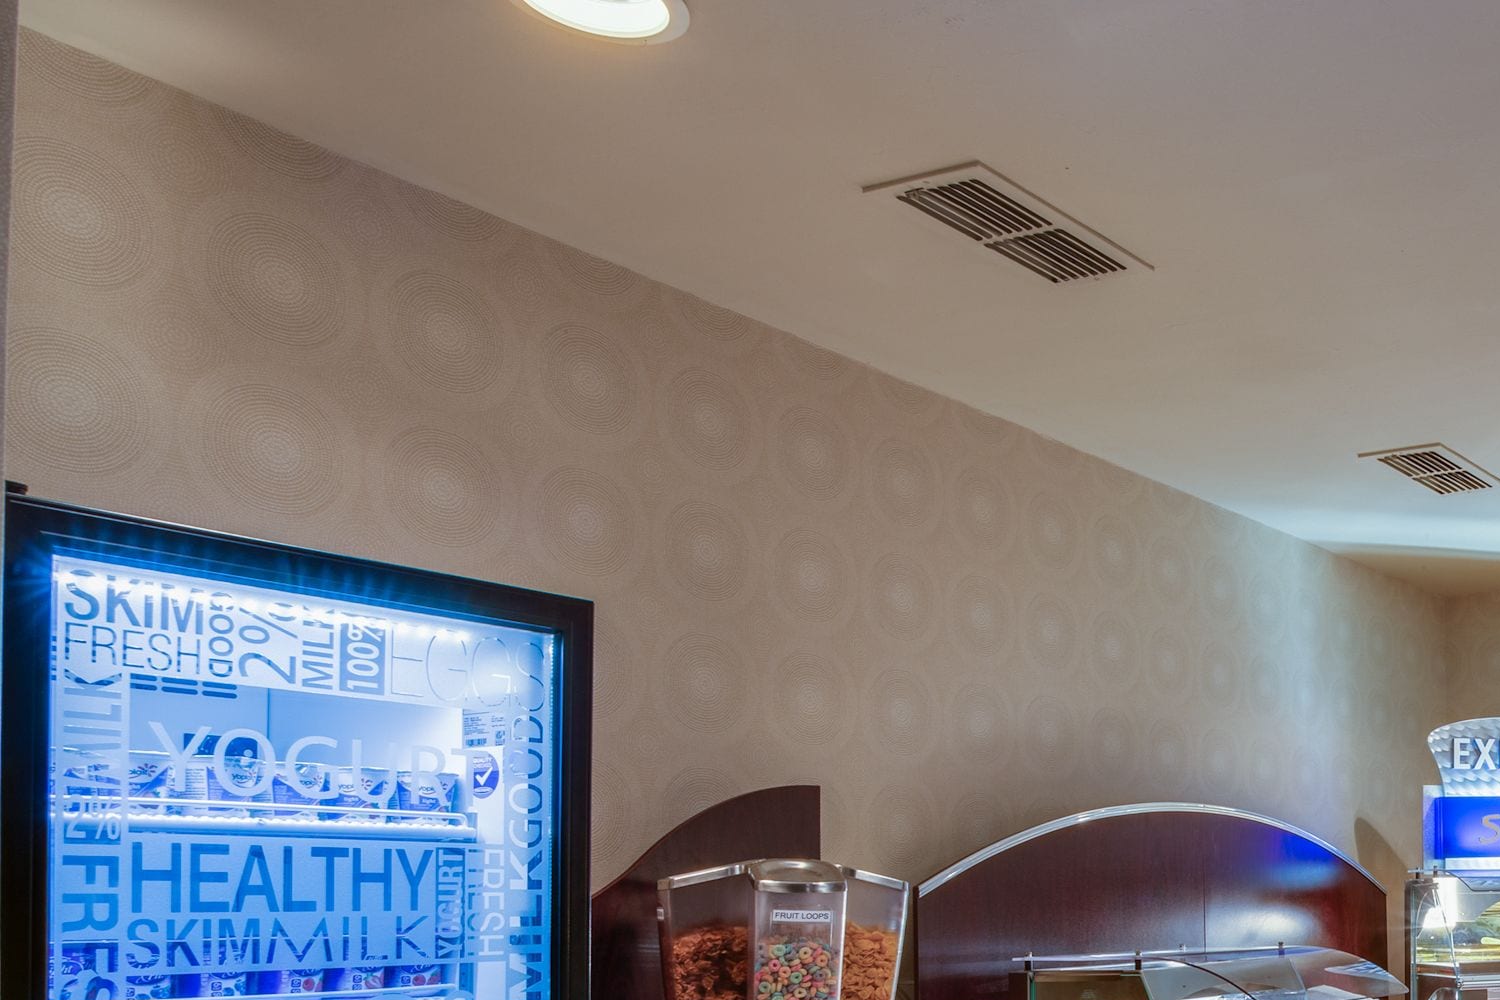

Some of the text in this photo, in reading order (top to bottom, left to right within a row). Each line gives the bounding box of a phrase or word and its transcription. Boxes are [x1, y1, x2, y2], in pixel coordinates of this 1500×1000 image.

[65, 569, 204, 635] SKIM
[64, 622, 201, 675] FRESH
[148, 721, 487, 808] YOGURT
[130, 841, 434, 913] HEALTHY
[775, 911, 830, 920] FRUIT LOOPS
